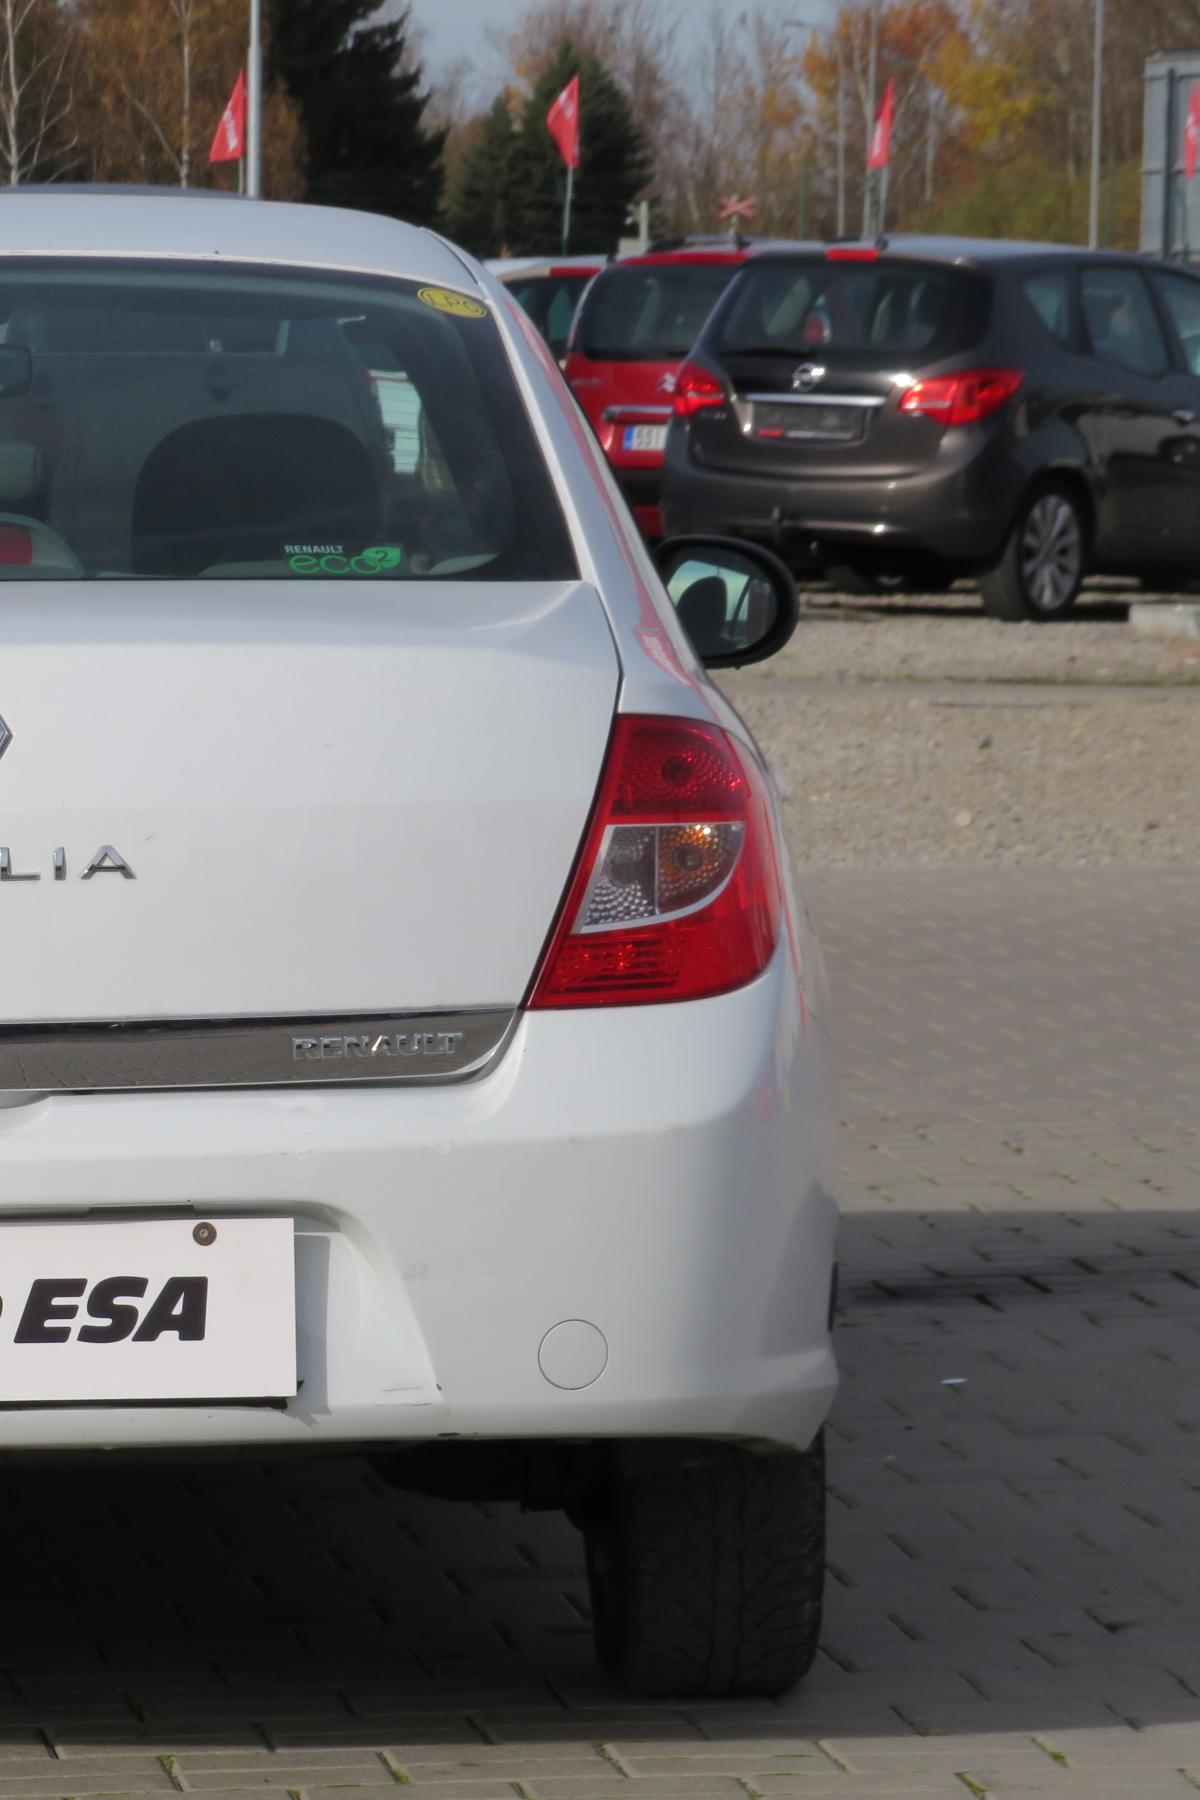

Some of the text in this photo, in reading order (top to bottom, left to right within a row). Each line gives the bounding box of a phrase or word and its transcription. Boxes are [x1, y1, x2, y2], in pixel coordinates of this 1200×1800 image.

[284, 545, 344, 554] RENAULT
[292, 1031, 464, 1060] RENAULT
[13, 1276, 208, 1343] ESA
